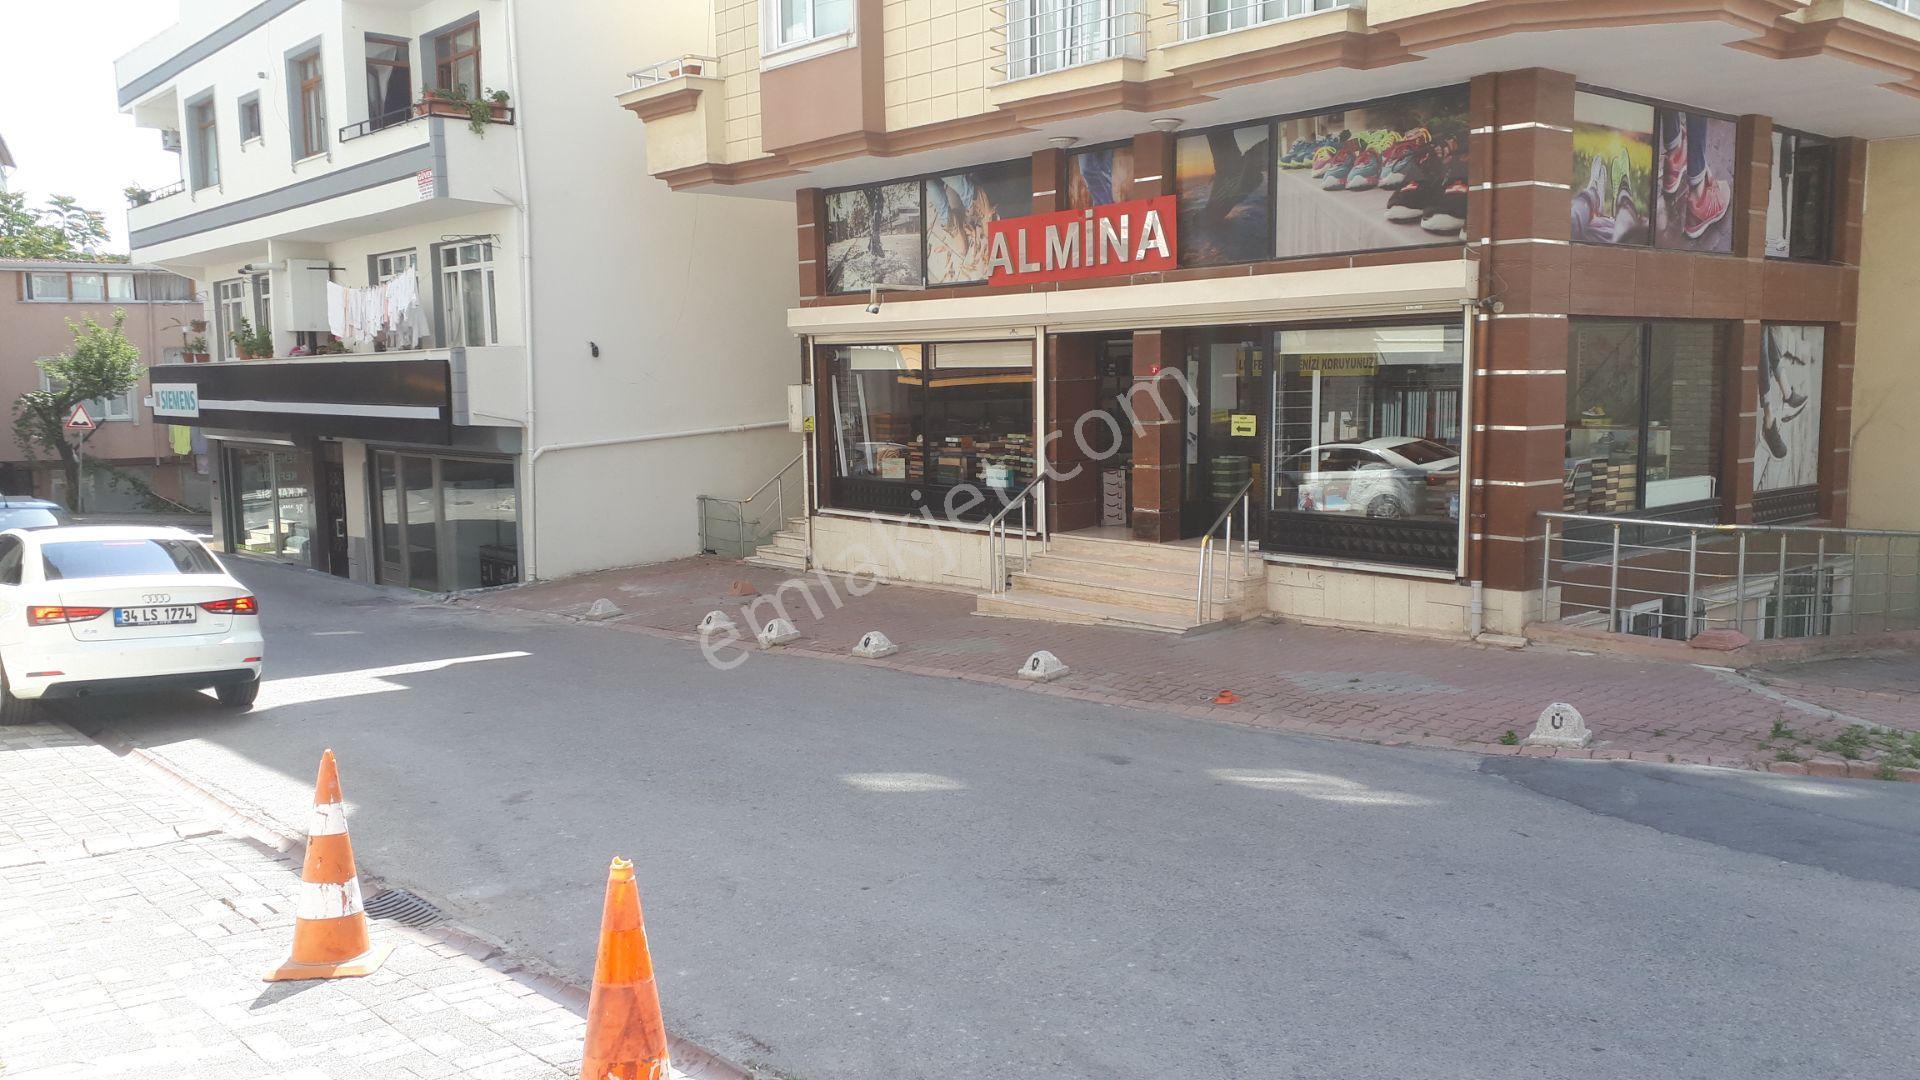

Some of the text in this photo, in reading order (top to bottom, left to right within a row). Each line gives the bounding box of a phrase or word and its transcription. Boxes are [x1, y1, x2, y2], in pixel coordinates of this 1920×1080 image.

[987, 208, 1170, 277] ALMİNA
[1321, 356, 1375, 370] KORUYUNUZ
[160, 390, 195, 411] SIEMENS
[123, 607, 193, 622] 34 LS 1774
